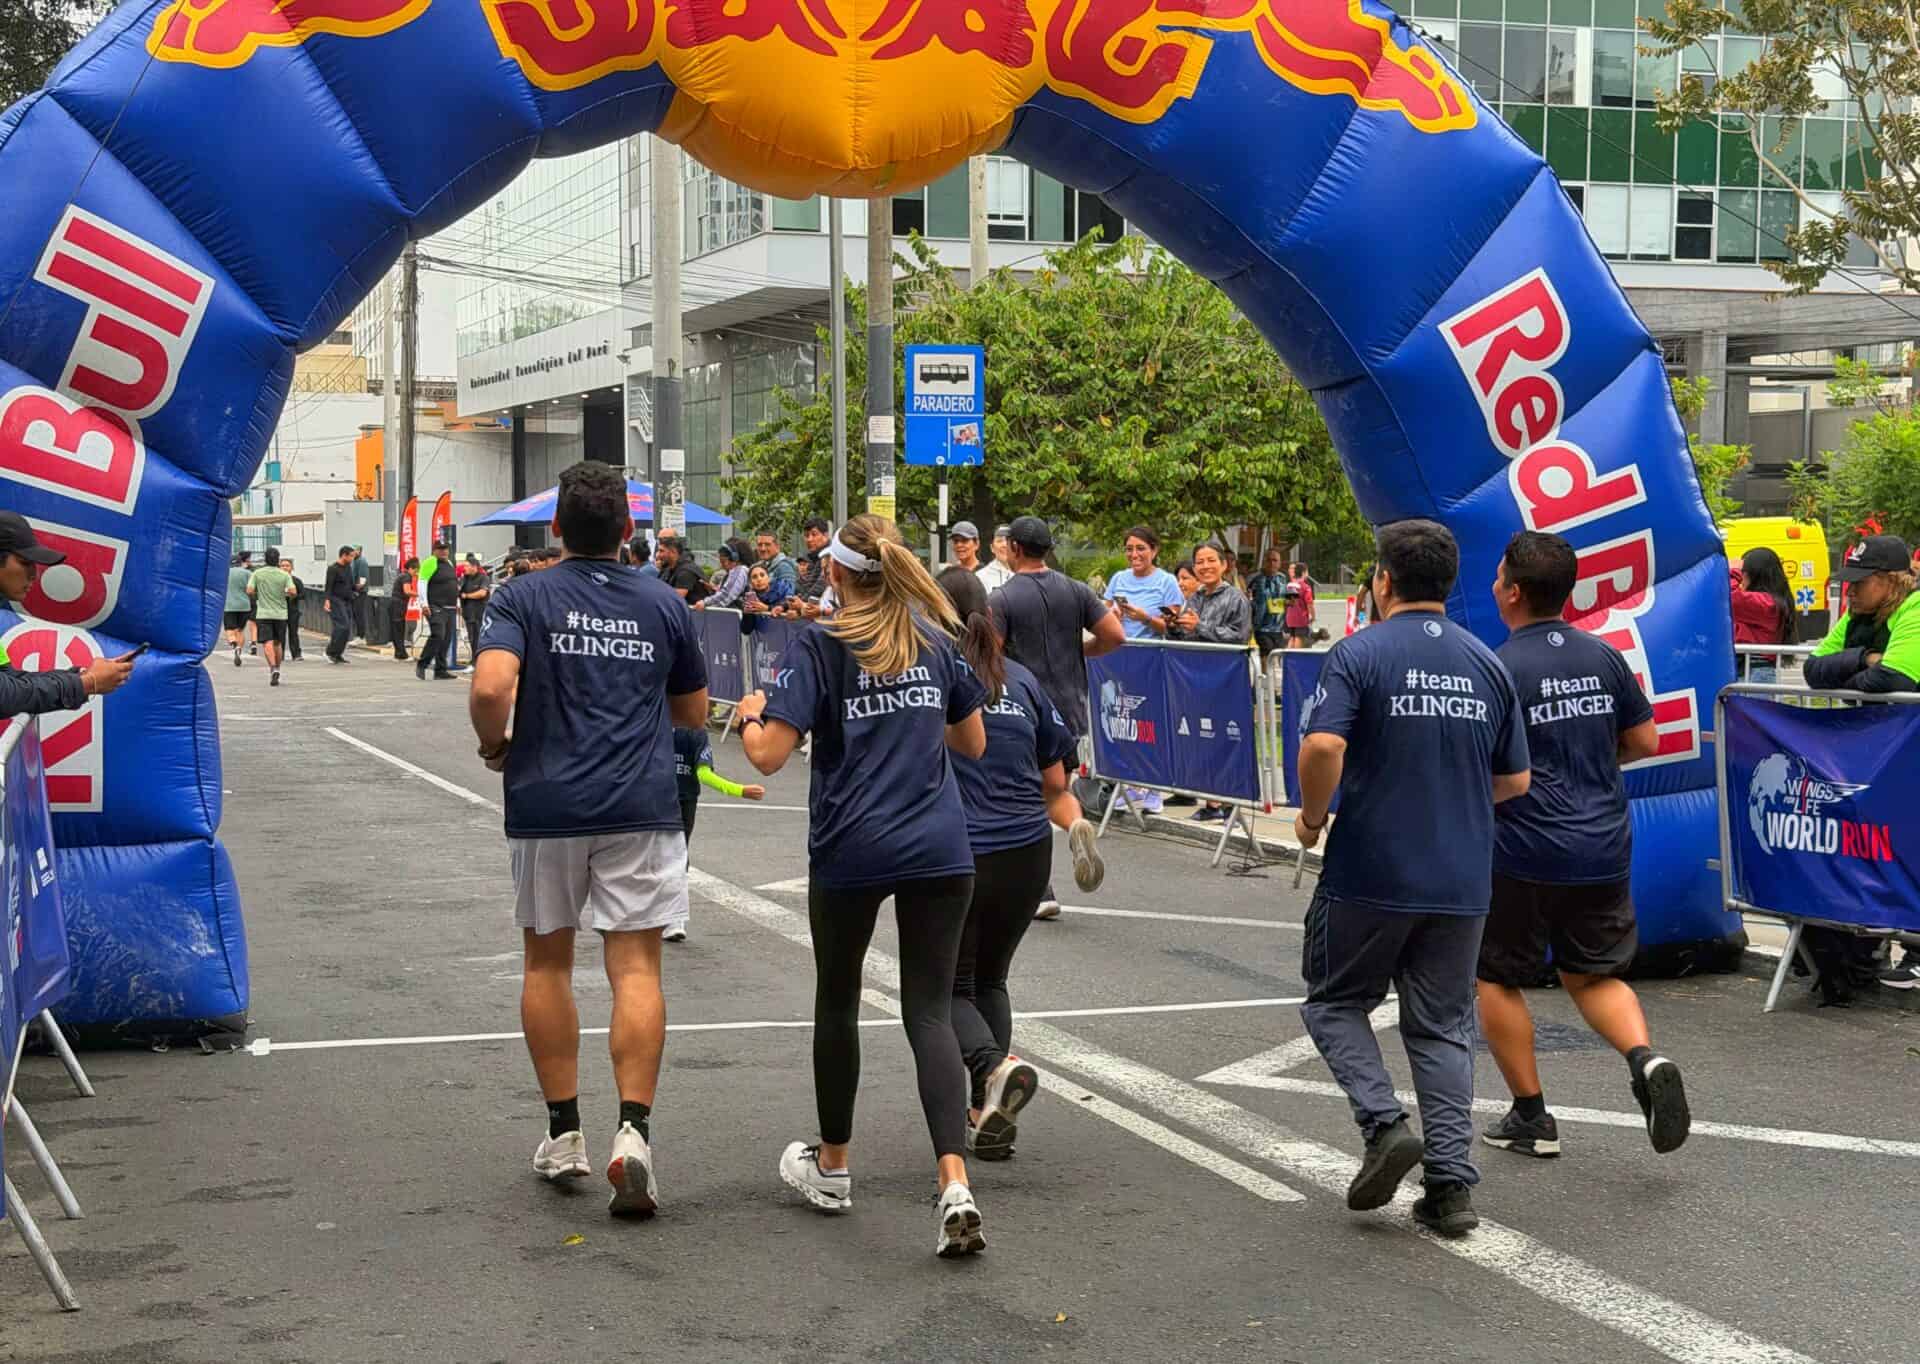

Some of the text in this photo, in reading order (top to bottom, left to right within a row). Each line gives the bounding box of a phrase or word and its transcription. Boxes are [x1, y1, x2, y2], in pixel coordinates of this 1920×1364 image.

[913, 396, 975, 412] PARADERO
[1442, 270, 1643, 531] Red
[566, 611, 640, 635] #team
[550, 633, 655, 662] KLINGER
[857, 664, 932, 689] #team
[1405, 669, 1473, 693] #team
[1540, 675, 1601, 698] #team
[844, 686, 942, 721] KLINGER
[1390, 695, 1488, 722] KLINGER
[1528, 695, 1615, 726] KLINGER
[1110, 716, 1138, 742] WORLD
[1787, 776, 1834, 800] WINGS
[1793, 797, 1821, 816] LIFE
[1766, 811, 1893, 863] WORLD RUN
